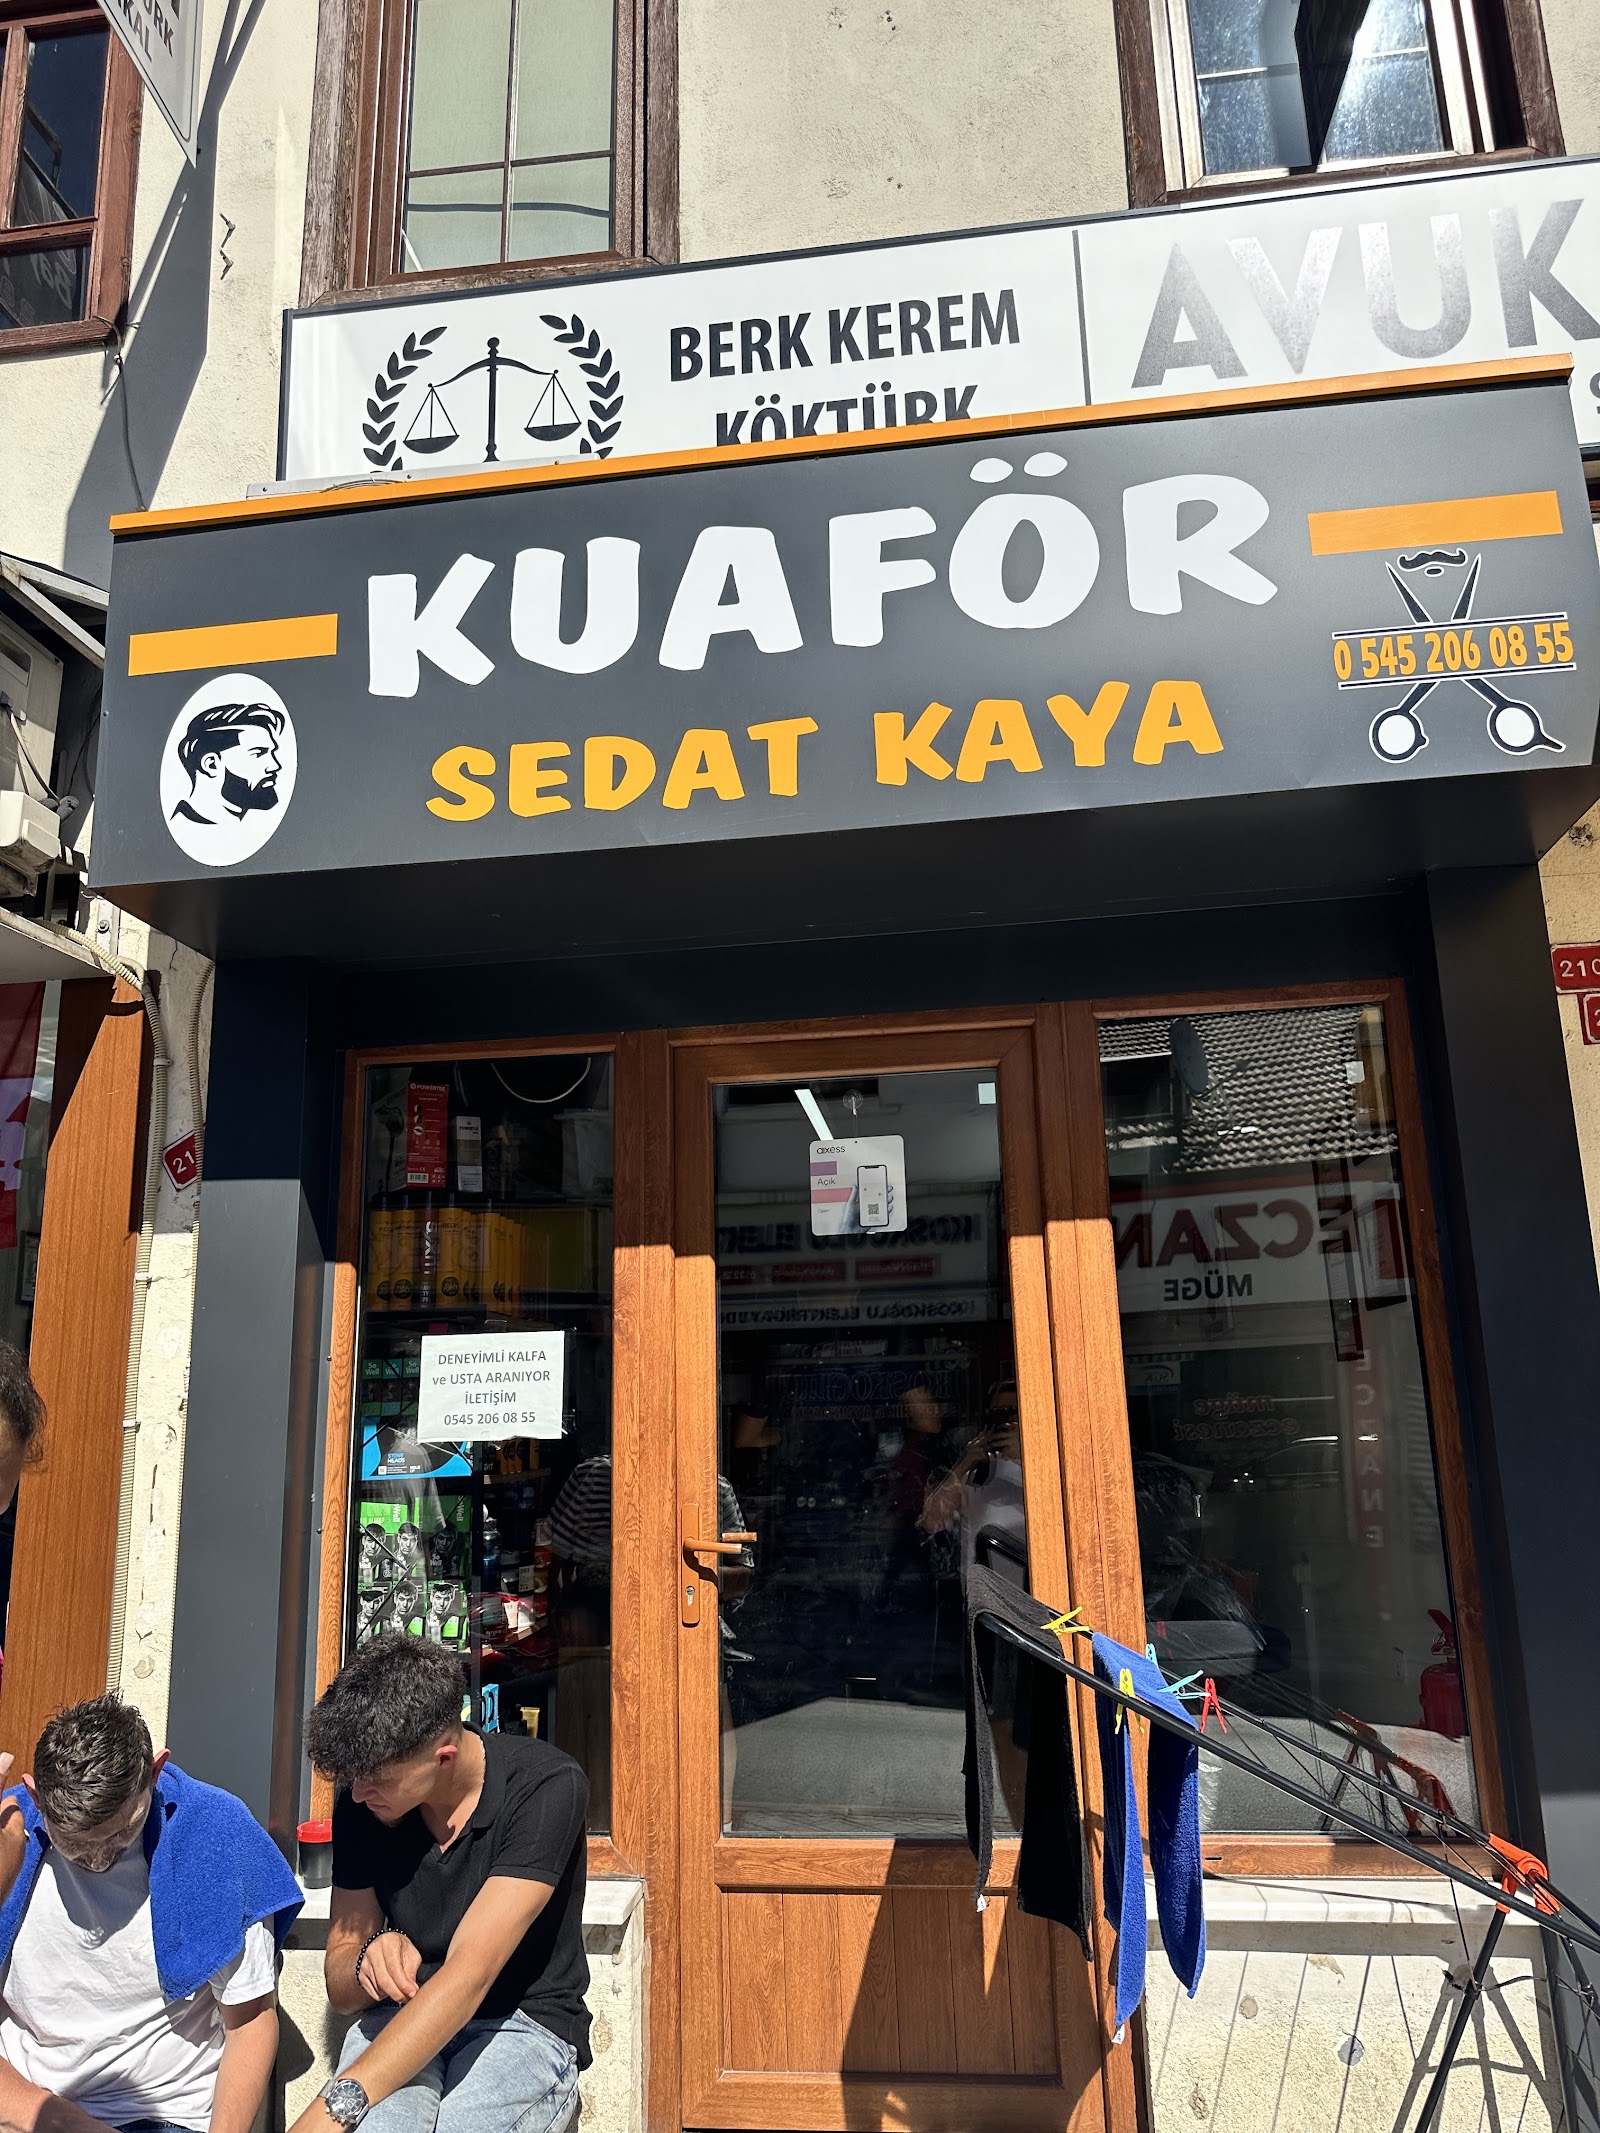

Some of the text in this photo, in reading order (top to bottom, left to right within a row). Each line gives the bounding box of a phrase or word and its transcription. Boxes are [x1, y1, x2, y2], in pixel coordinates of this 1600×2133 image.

[670, 288, 1020, 382] BERK KEREM
[367, 451, 1278, 698] KUAFÖR
[1333, 621, 1575, 681] 0 545 206 08 55
[426, 679, 1224, 822] SEDAT KAYA
[438, 1350, 547, 1365] DENEYİMLİ KALFA
[432, 1370, 550, 1385] ve USTA ARANIYOR
[465, 1390, 516, 1406] İLETİŞİM
[444, 1411, 536, 1425] 0545 206 08 55
